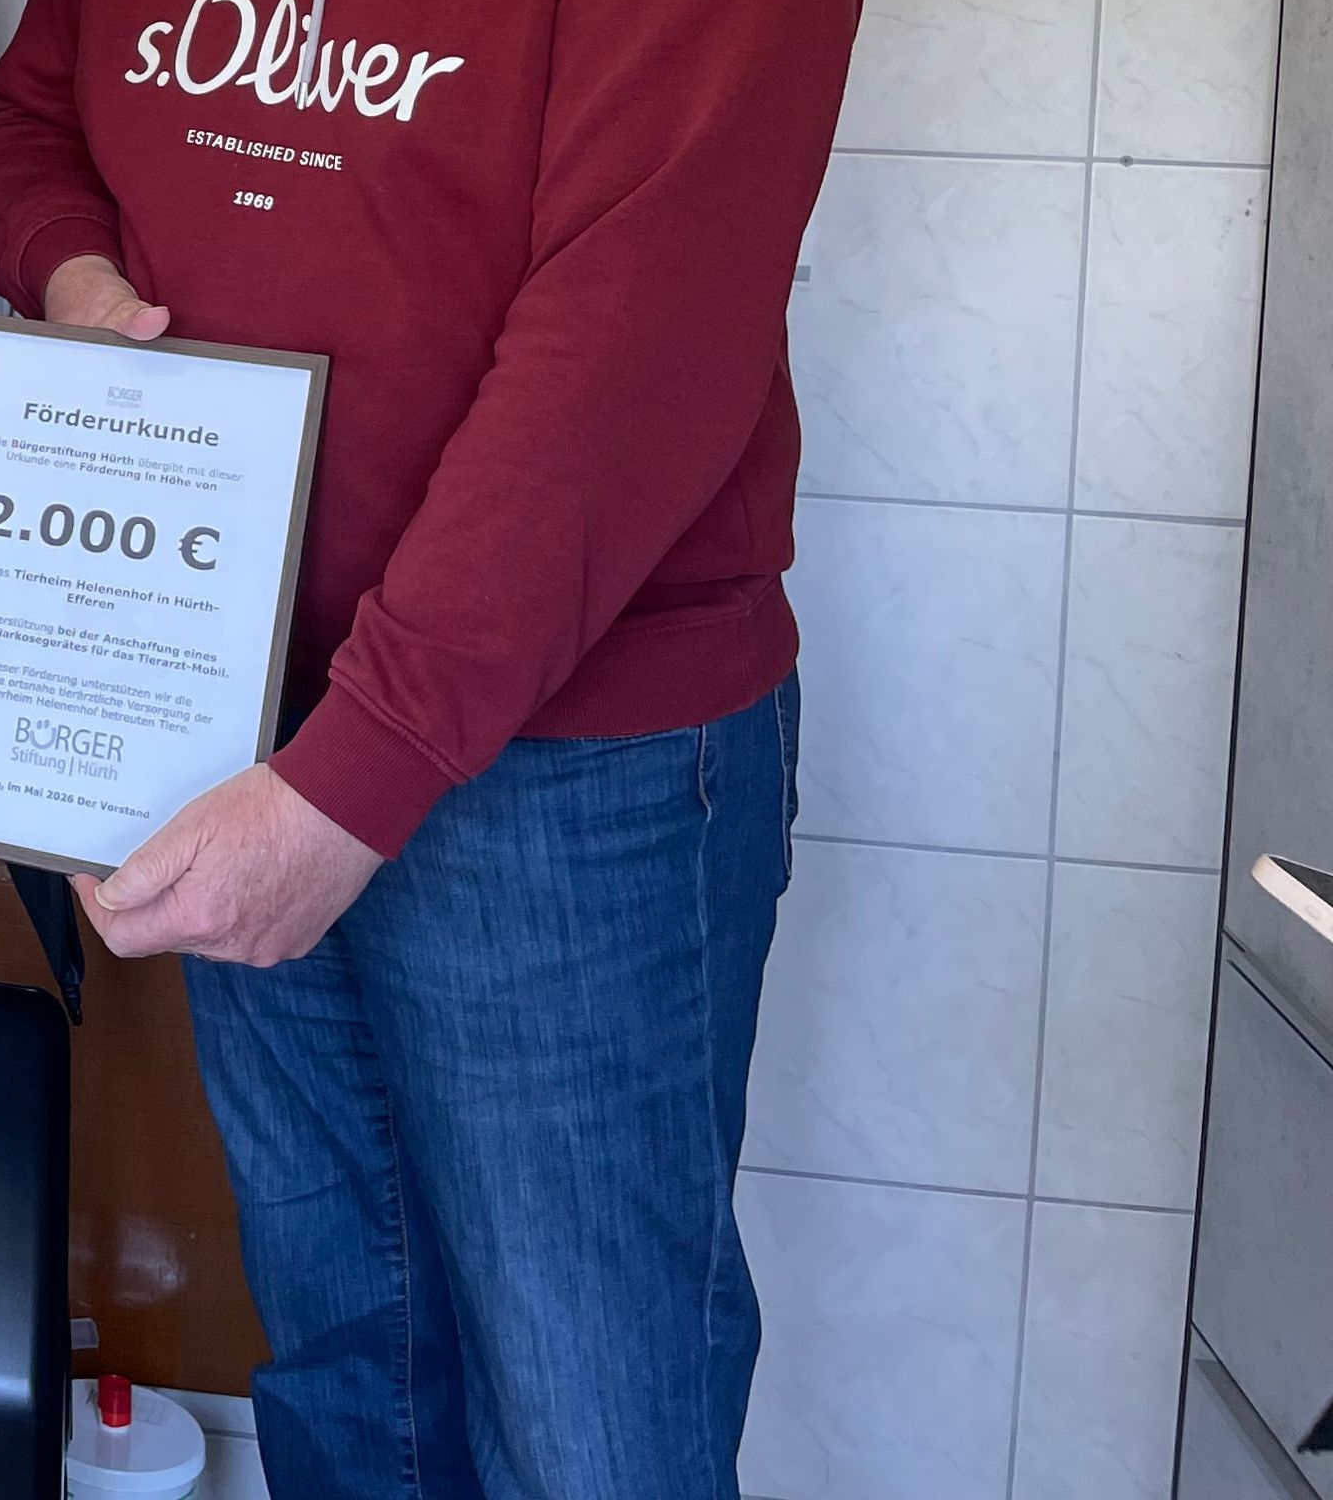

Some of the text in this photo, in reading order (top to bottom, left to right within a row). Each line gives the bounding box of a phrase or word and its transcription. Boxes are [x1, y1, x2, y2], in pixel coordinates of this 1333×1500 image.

[186, 129, 343, 171] ESTABLISHED SINCE
[233, 191, 275, 211] 1969
[23, 402, 219, 447] Förderurkunde
[6, 451, 50, 467] Urkunde
[54, 457, 77, 470] eine
[79, 462, 141, 481] Förderung
[160, 473, 192, 487] Höhe
[195, 480, 217, 491] von
[11, 438, 96, 461] Bürgerstiftung
[100, 452, 134, 466] Hürth
[187, 464, 206, 477] mit
[178, 526, 221, 571] €
[14, 568, 72, 589] Tierheim
[75, 578, 153, 602] Helenenhof
[156, 591, 170, 605] in
[173, 595, 220, 612] Hürth-
[66, 592, 115, 611] Efferen
[57, 625, 76, 638] bei
[79, 629, 100, 642] der
[102, 633, 180, 658] Anschaffung
[183, 650, 218, 663] eines
[91, 644, 110, 657] für
[113, 649, 134, 662] das
[138, 653, 229, 679] Tierarzt-Mobil.
[8, 677, 55, 695] ortsnahe
[127, 700, 191, 724] Versorgung
[194, 711, 214, 725] der
[22, 666, 78, 688] Förderung
[81, 678, 151, 699] unterstützen
[154, 691, 172, 703] wir
[36, 695, 100, 717] Helenenhof
[102, 708, 155, 728] betreuten
[14, 716, 124, 763] BÜRGER
[7, 781, 21, 793] im
[24, 785, 43, 798] Mai
[46, 790, 74, 804] 2026
[77, 796, 97, 808] Der
[100, 800, 150, 819] Vorstand
